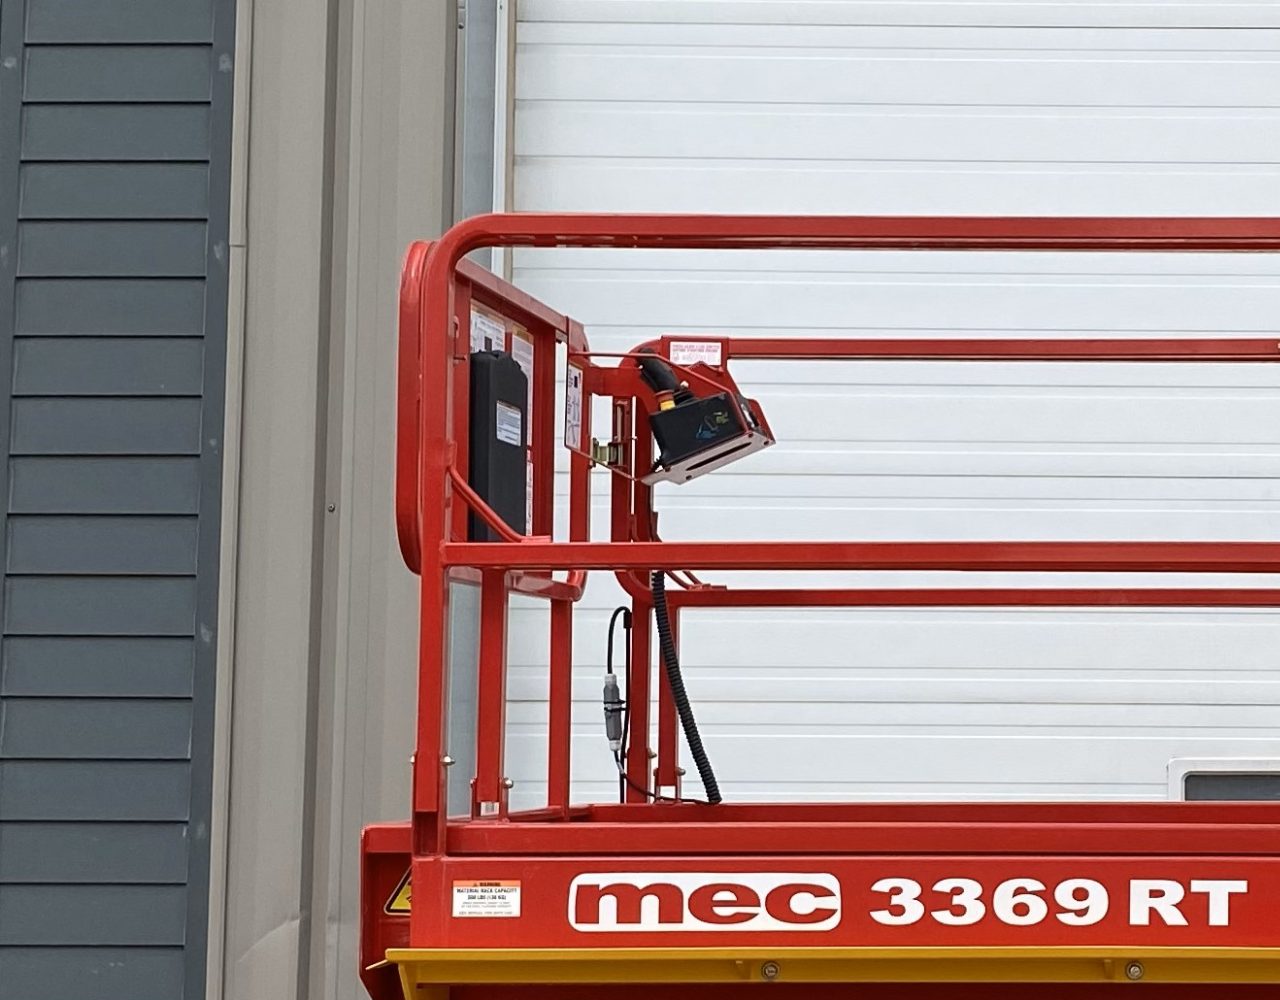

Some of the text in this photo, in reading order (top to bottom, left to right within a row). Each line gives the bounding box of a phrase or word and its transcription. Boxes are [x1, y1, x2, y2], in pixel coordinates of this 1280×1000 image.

[573, 878, 1248, 926] mec 3369 RT
